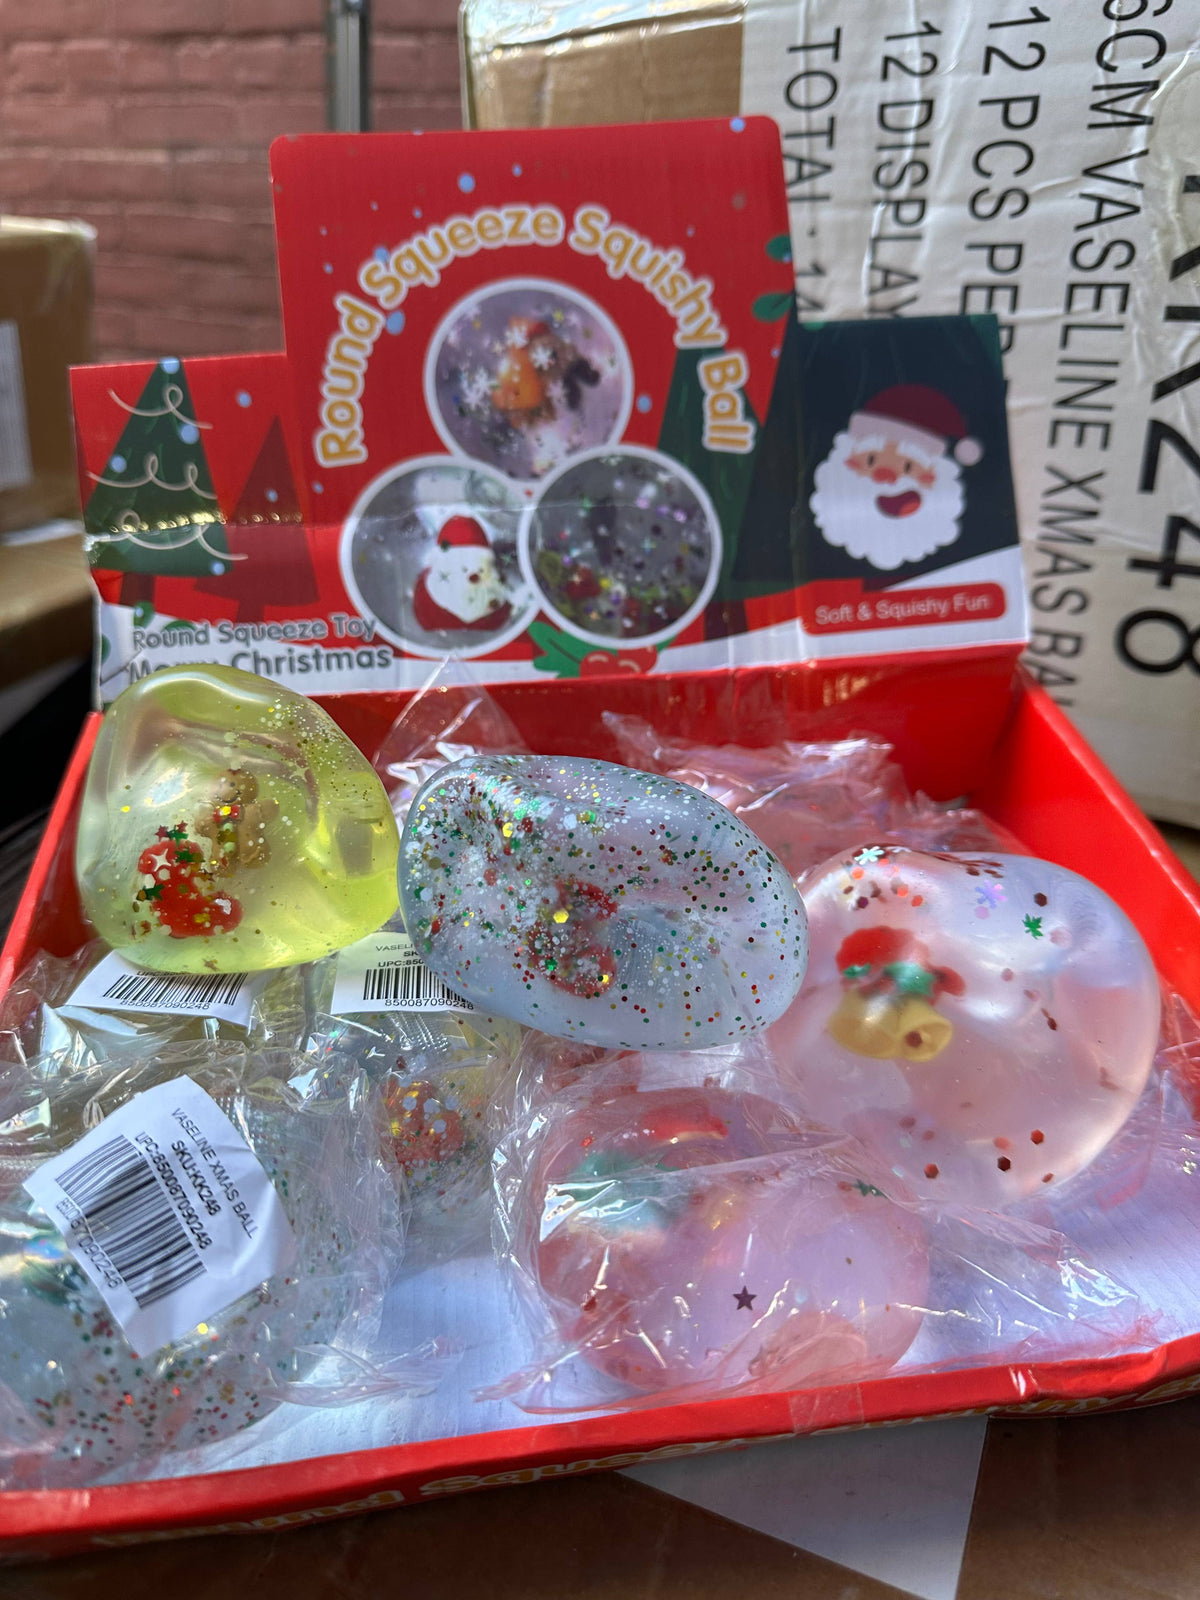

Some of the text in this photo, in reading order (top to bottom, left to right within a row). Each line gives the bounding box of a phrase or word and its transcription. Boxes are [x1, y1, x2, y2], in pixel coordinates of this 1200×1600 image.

[881, 20, 941, 82] 12
[982, 6, 1051, 76] 12
[968, 95, 1040, 222] PCS
[315, 205, 753, 464] Round Squeeze Squishy Ball
[1047, 148, 1150, 451] VASELINE
[1030, 463, 1107, 616] XMAS
[133, 615, 376, 650] Round Squeeze Toy
[815, 592, 991, 625] Soft & Squishy Fun
[231, 647, 393, 676] Christmas
[375, 943, 414, 952] VASELI
[134, 1130, 213, 1250] UPC:850087090248
[171, 1139, 222, 1216] SKU:KK248
[172, 1107, 259, 1239] VASELINE XMAS BALL
